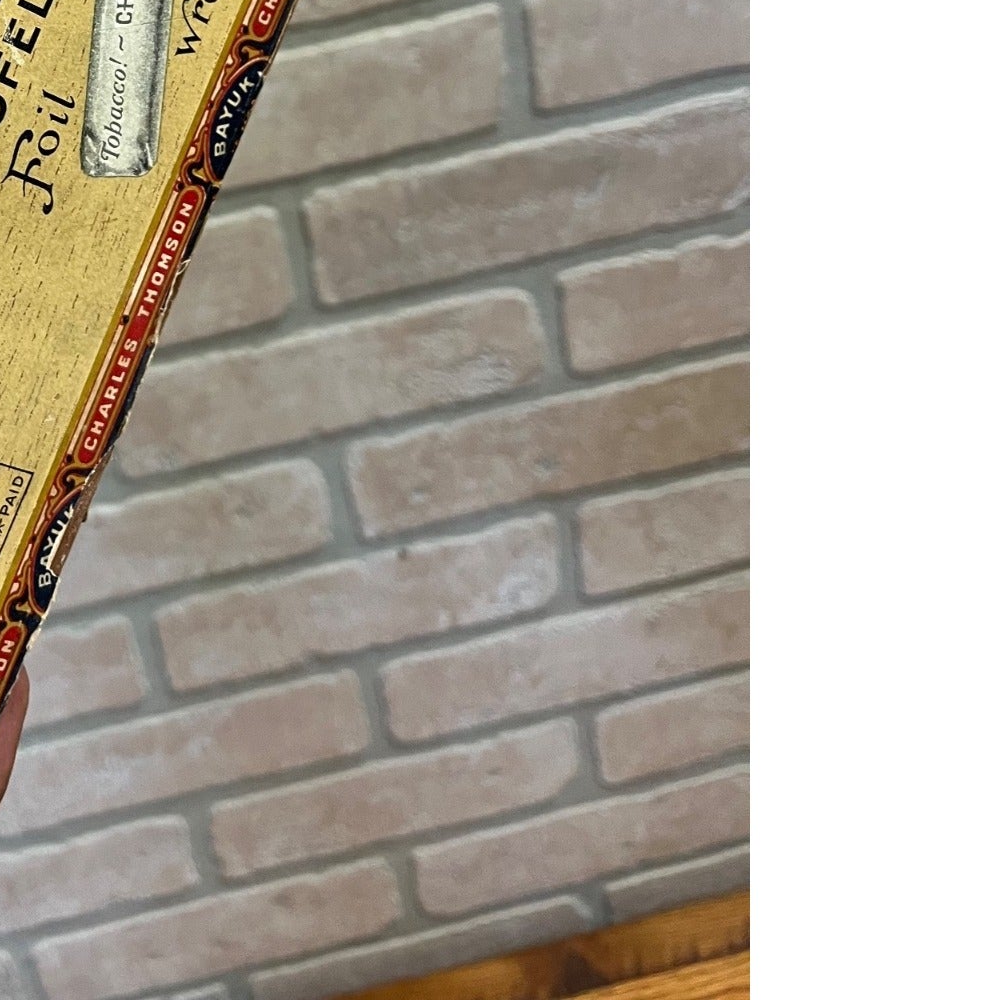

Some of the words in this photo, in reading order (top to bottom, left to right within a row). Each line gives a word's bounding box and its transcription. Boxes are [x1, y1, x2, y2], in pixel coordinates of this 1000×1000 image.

[0, 88, 72, 214] Foil
[100, 55, 127, 158] Tobacco!
[214, 75, 254, 157] BAYUK
[83, 337, 140, 452] CHARLES
[138, 198, 195, 316] THOMSON
